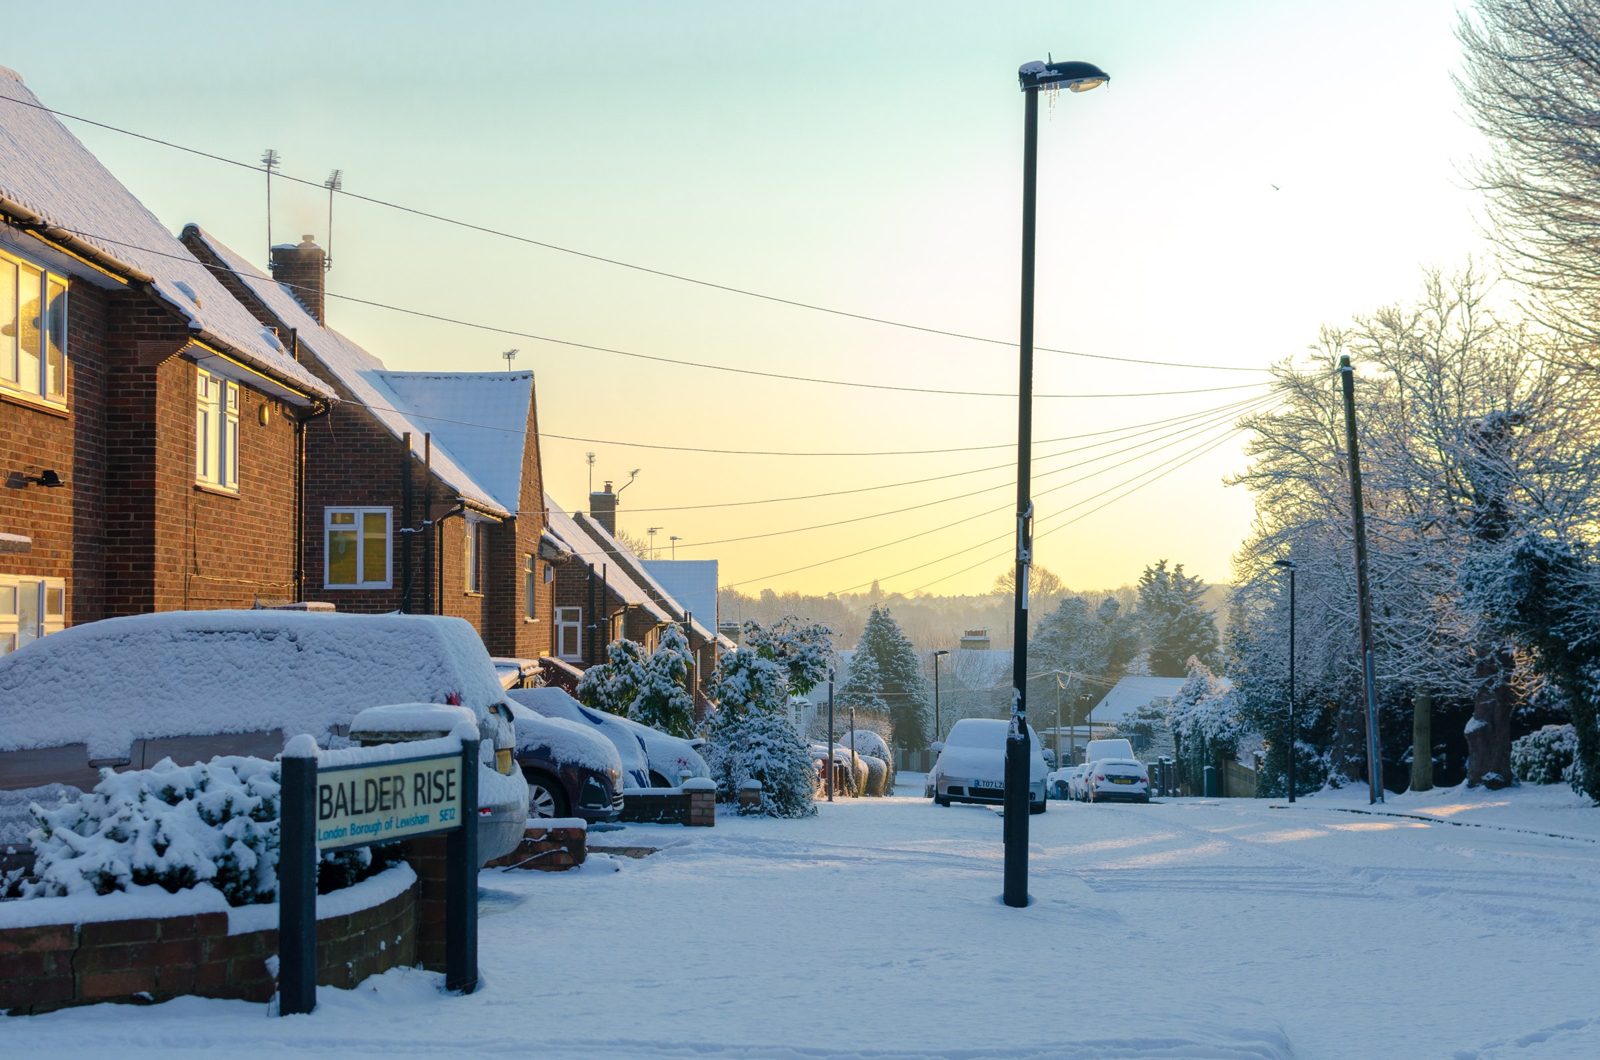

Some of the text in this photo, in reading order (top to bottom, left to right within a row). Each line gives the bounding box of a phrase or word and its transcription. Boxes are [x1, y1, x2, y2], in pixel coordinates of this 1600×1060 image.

[319, 768, 456, 820] BALDER RISE
[318, 808, 456, 842] London Borough of Lewisham SE12
